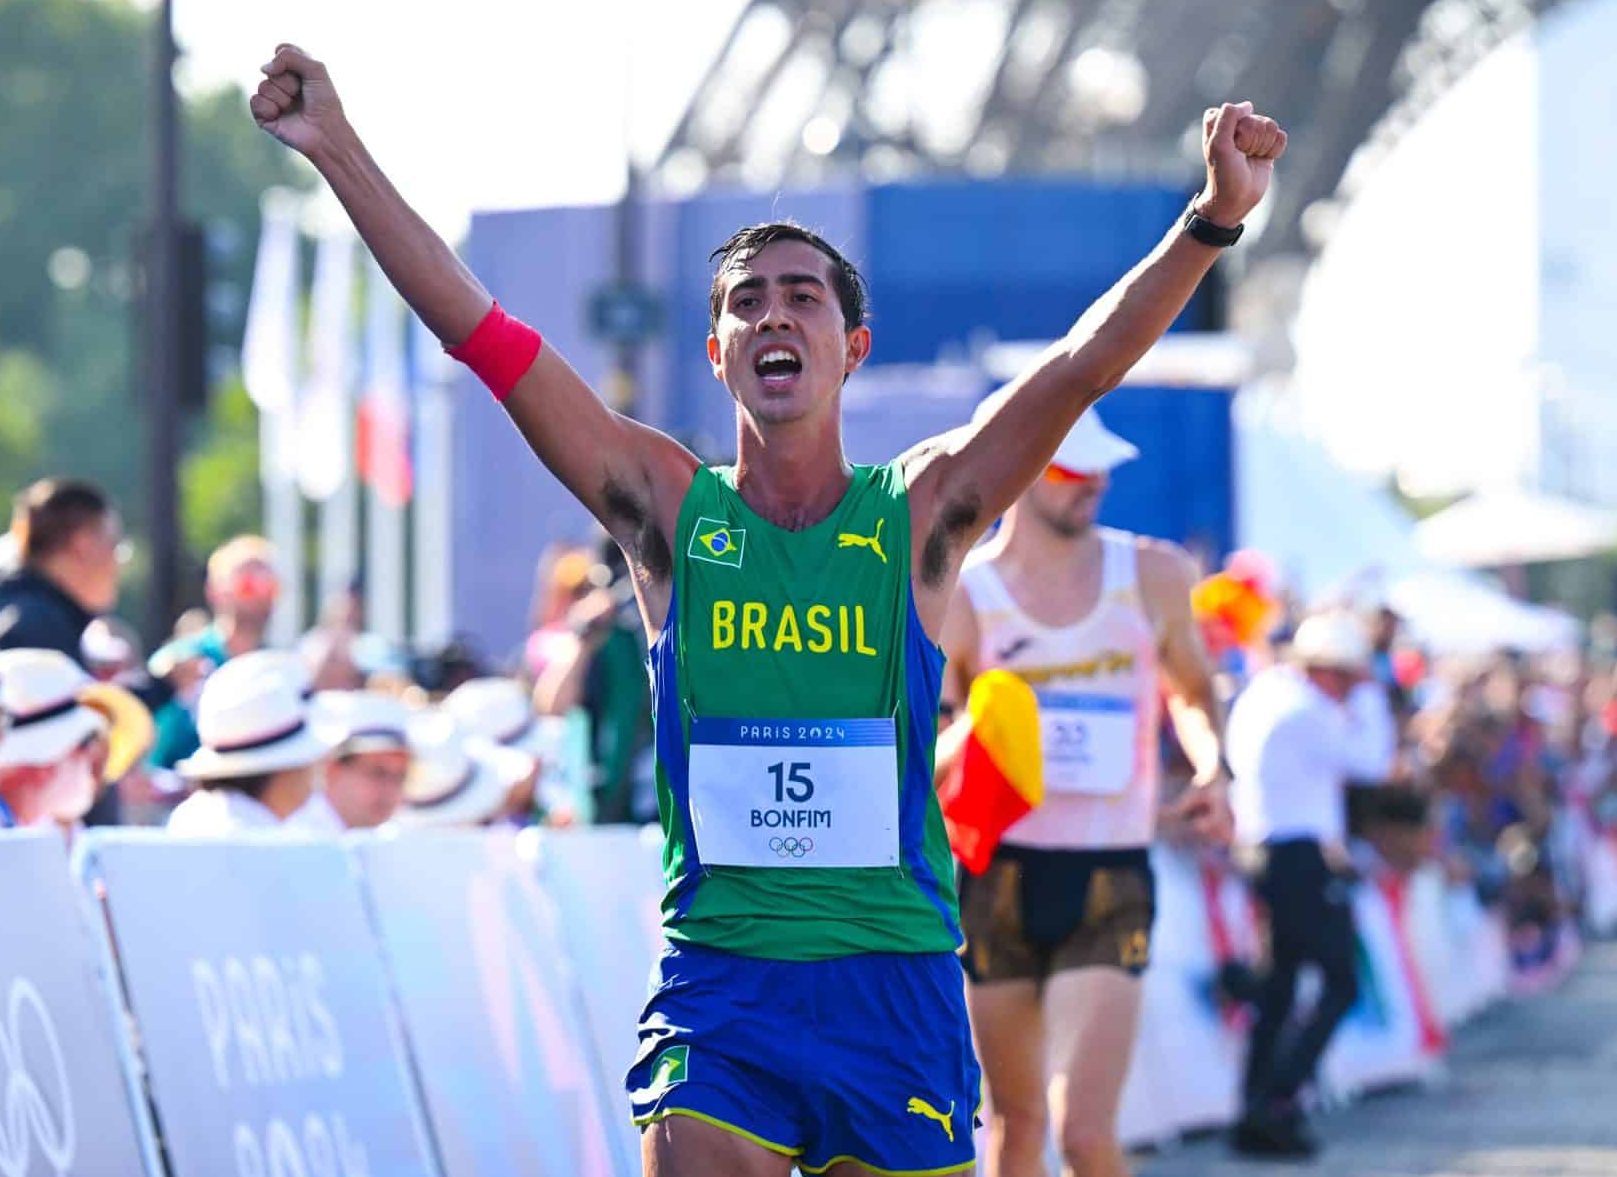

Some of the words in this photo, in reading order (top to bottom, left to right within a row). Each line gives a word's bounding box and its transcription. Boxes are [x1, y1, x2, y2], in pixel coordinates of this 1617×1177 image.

[712, 600, 877, 656] BRASIL
[798, 726, 845, 740] 2024
[767, 761, 814, 803] 15
[750, 809, 832, 829] BONFIM
